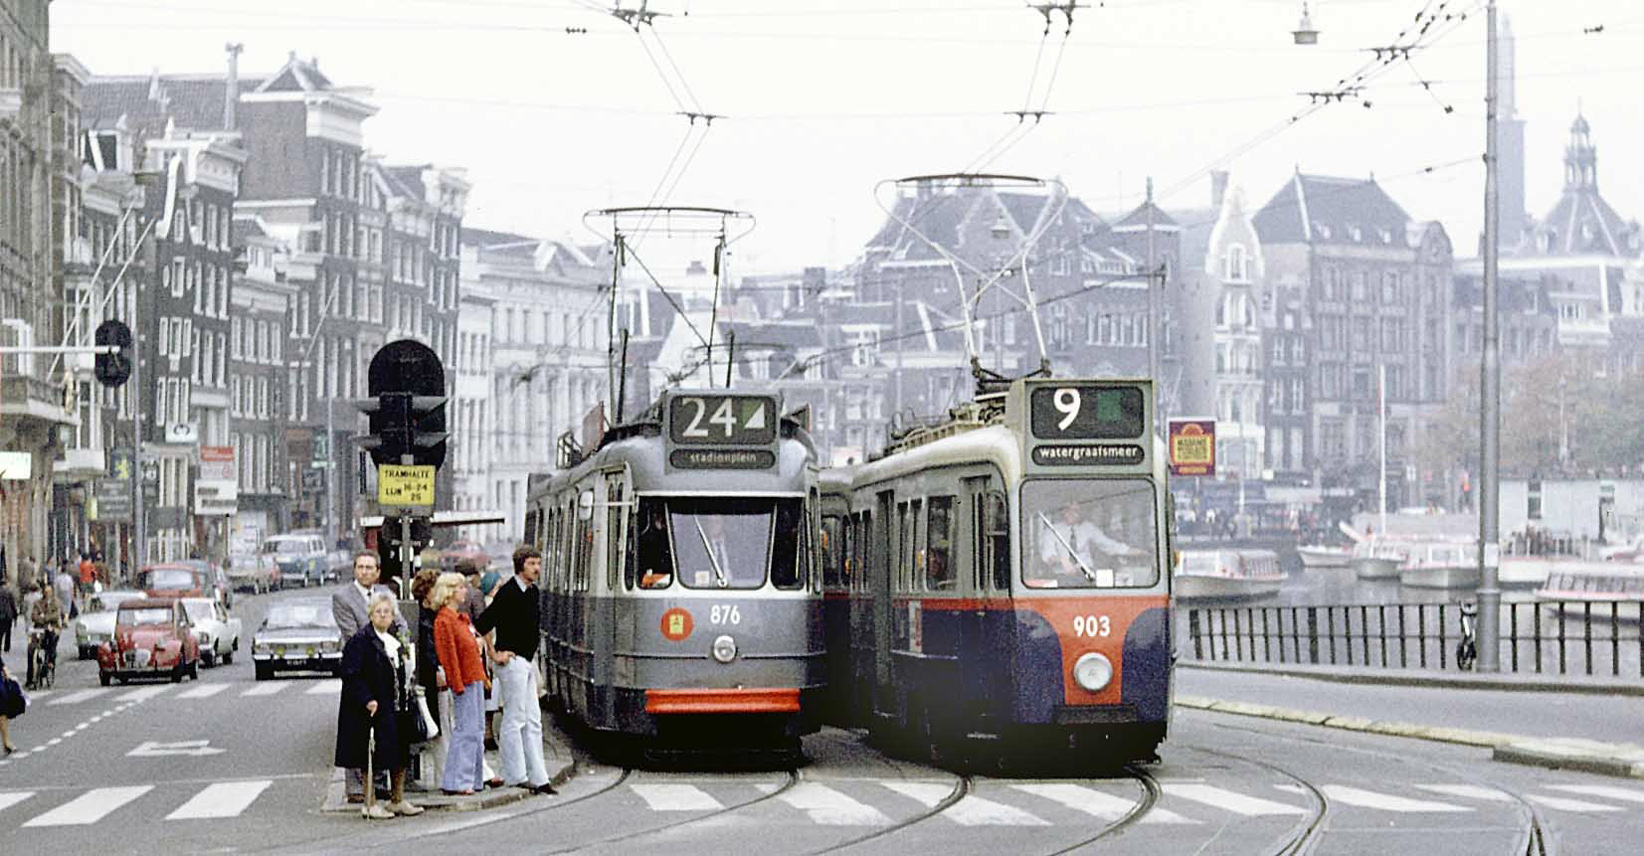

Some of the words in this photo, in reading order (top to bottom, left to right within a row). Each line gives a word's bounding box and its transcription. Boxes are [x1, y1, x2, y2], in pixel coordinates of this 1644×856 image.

[682, 397, 737, 438] 24
[1053, 387, 1081, 431] 9
[690, 453, 757, 464] stadionplein
[1039, 445, 1138, 461] watergraafsmeer
[384, 469, 430, 479] TRAMHALTE
[710, 604, 741, 625] 876
[1073, 615, 1111, 637] 903
